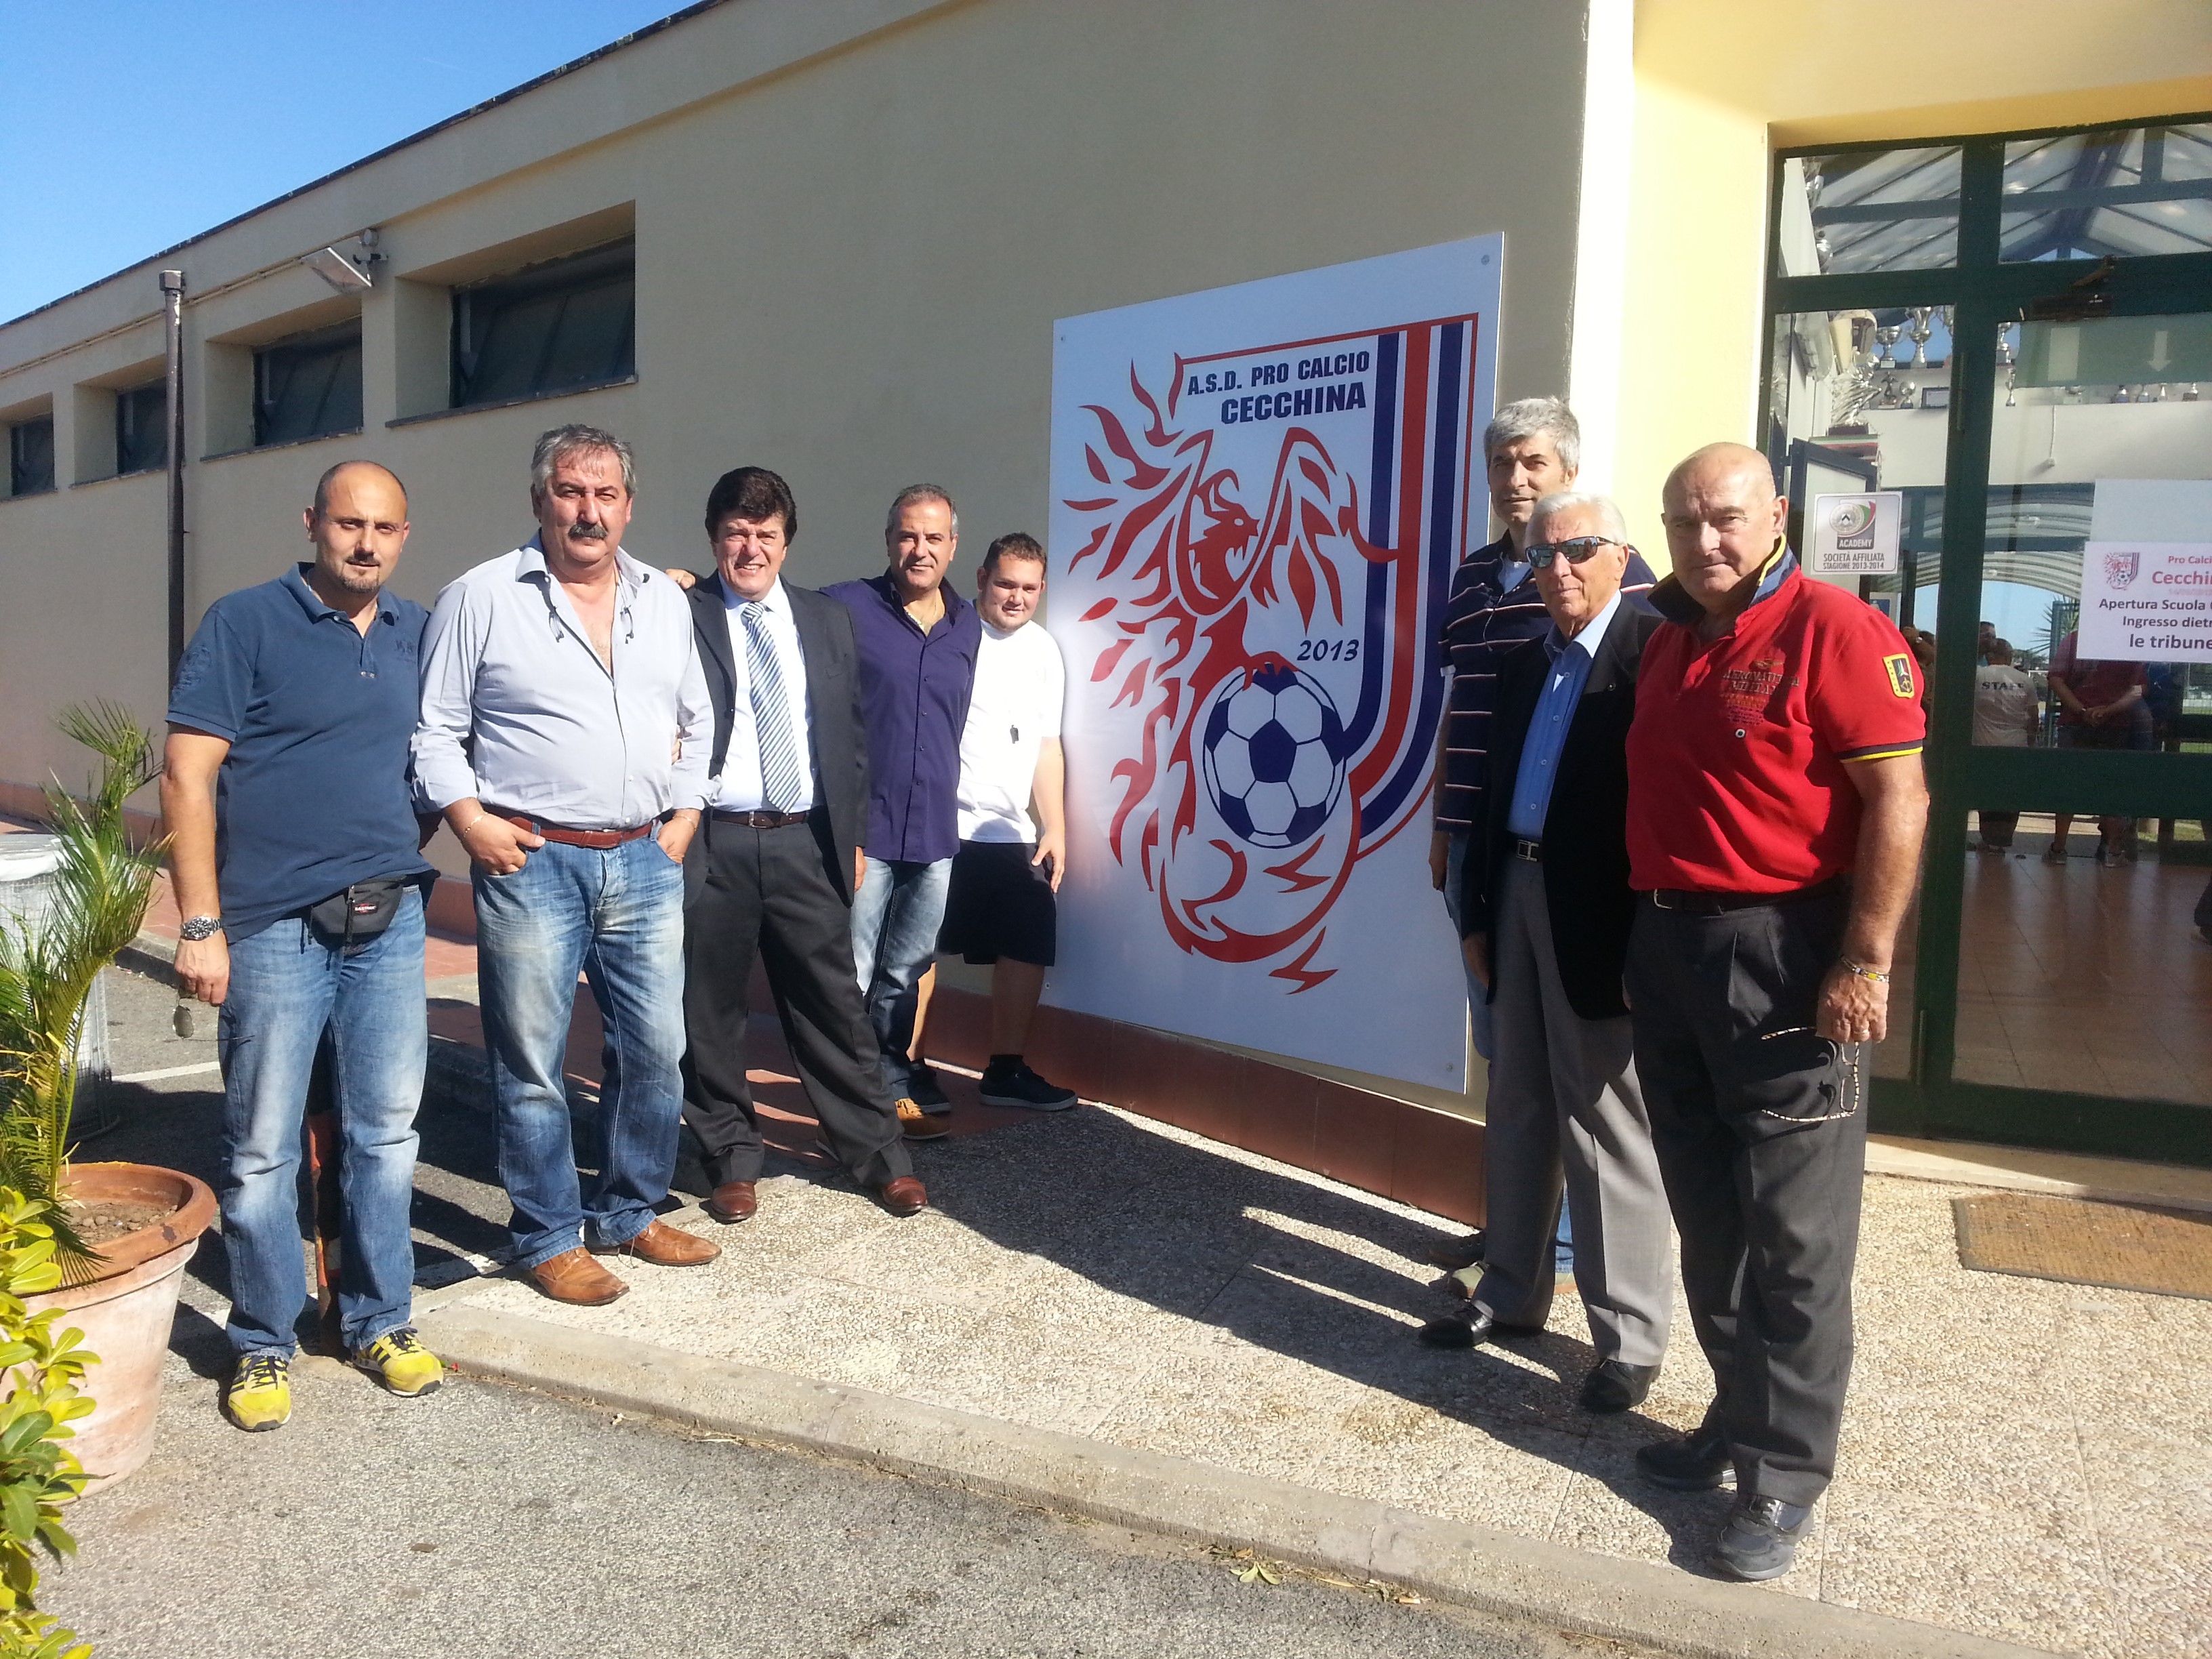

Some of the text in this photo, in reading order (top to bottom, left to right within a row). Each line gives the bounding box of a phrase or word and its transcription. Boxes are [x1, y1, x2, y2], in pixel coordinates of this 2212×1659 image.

[1187, 350, 1370, 396] A.S.D. PRO CALCIO
[1221, 382, 1366, 424] CECCHINA
[1839, 539, 1872, 548] ACADEMY
[1823, 551, 1885, 562] SOCIETÀ AFFILIATA
[2168, 556, 2186, 564] Pro
[2099, 598, 2158, 611] Apertura
[2162, 600, 2205, 610] Scuola
[2123, 616, 2178, 628] Ingresso
[2129, 634, 2145, 647] le
[1296, 639, 1359, 661] 2013
